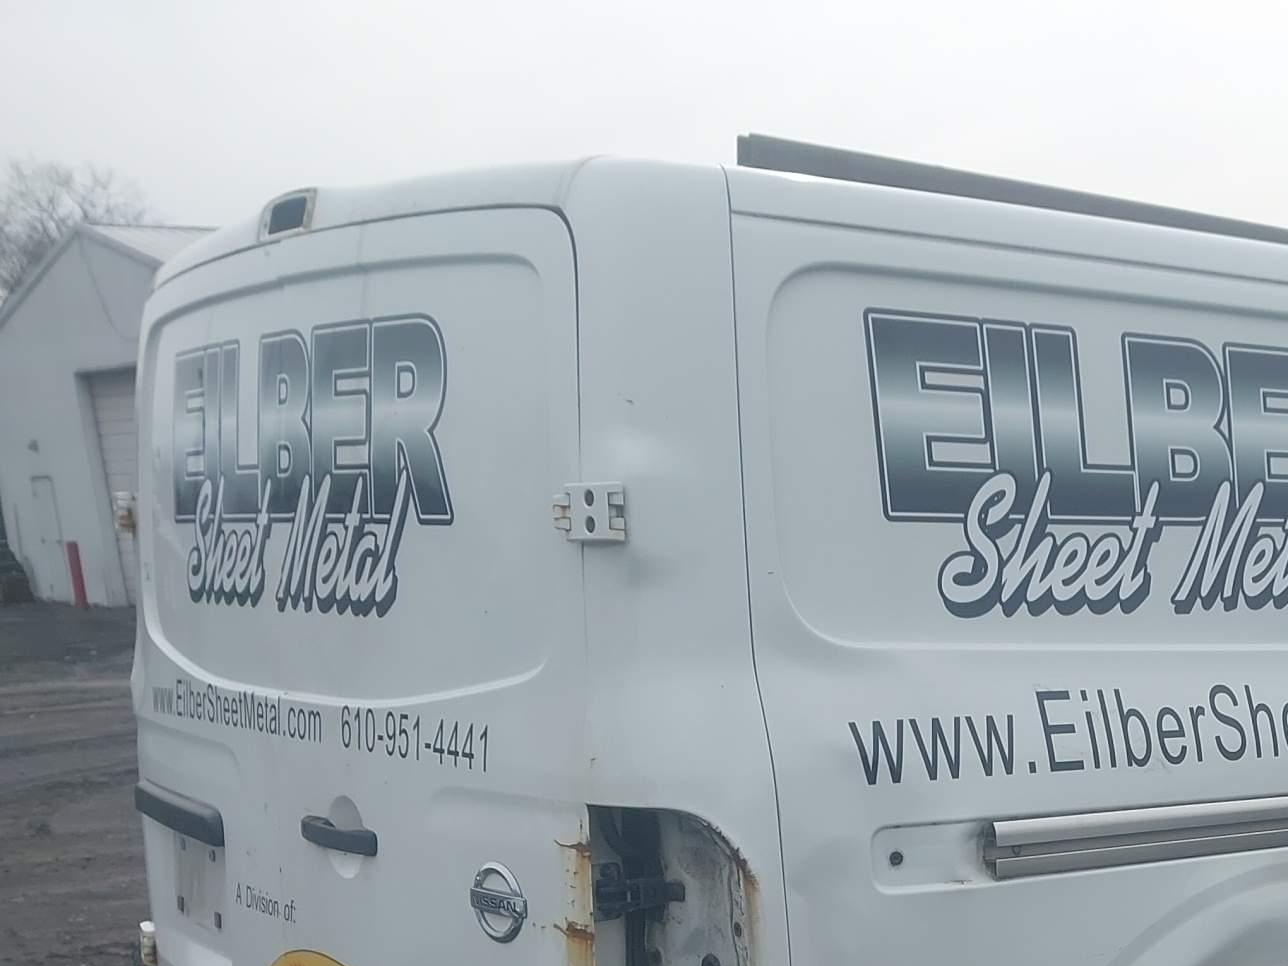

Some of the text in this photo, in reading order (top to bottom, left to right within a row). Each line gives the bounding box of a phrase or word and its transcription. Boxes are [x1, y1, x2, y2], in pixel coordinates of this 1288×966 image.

[173, 312, 454, 526] EILBER
[187, 469, 410, 618] Sheet Metal
[937, 467, 1163, 619] Sheet
[153, 679, 488, 772] www.EilberSheetMetal.com 610-951-4441
[235, 881, 296, 924] A Division of:
[472, 894, 517, 914] NISSAN
